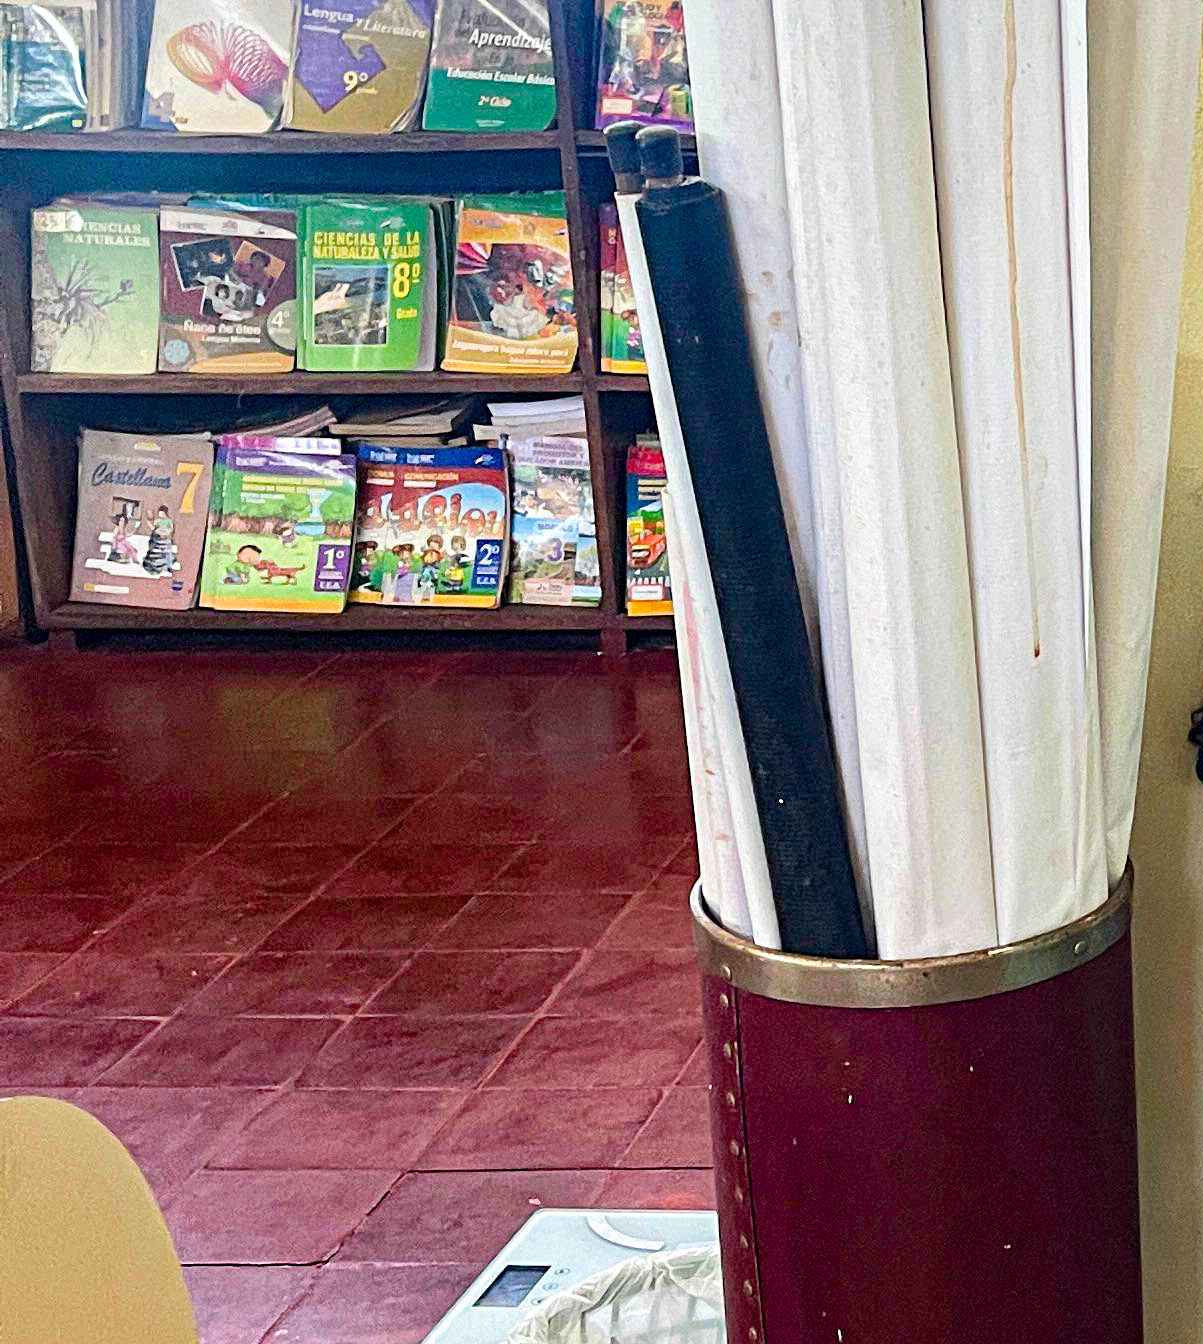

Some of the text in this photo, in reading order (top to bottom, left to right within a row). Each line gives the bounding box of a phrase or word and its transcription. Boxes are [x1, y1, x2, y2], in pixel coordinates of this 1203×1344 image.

[303, 4, 354, 24] Lengua
[83, 222, 141, 234] IENCIAS
[64, 233, 151, 247] NATURALES
[314, 231, 420, 246] CIENCIAS DE LA
[176, 460, 205, 513] 7
